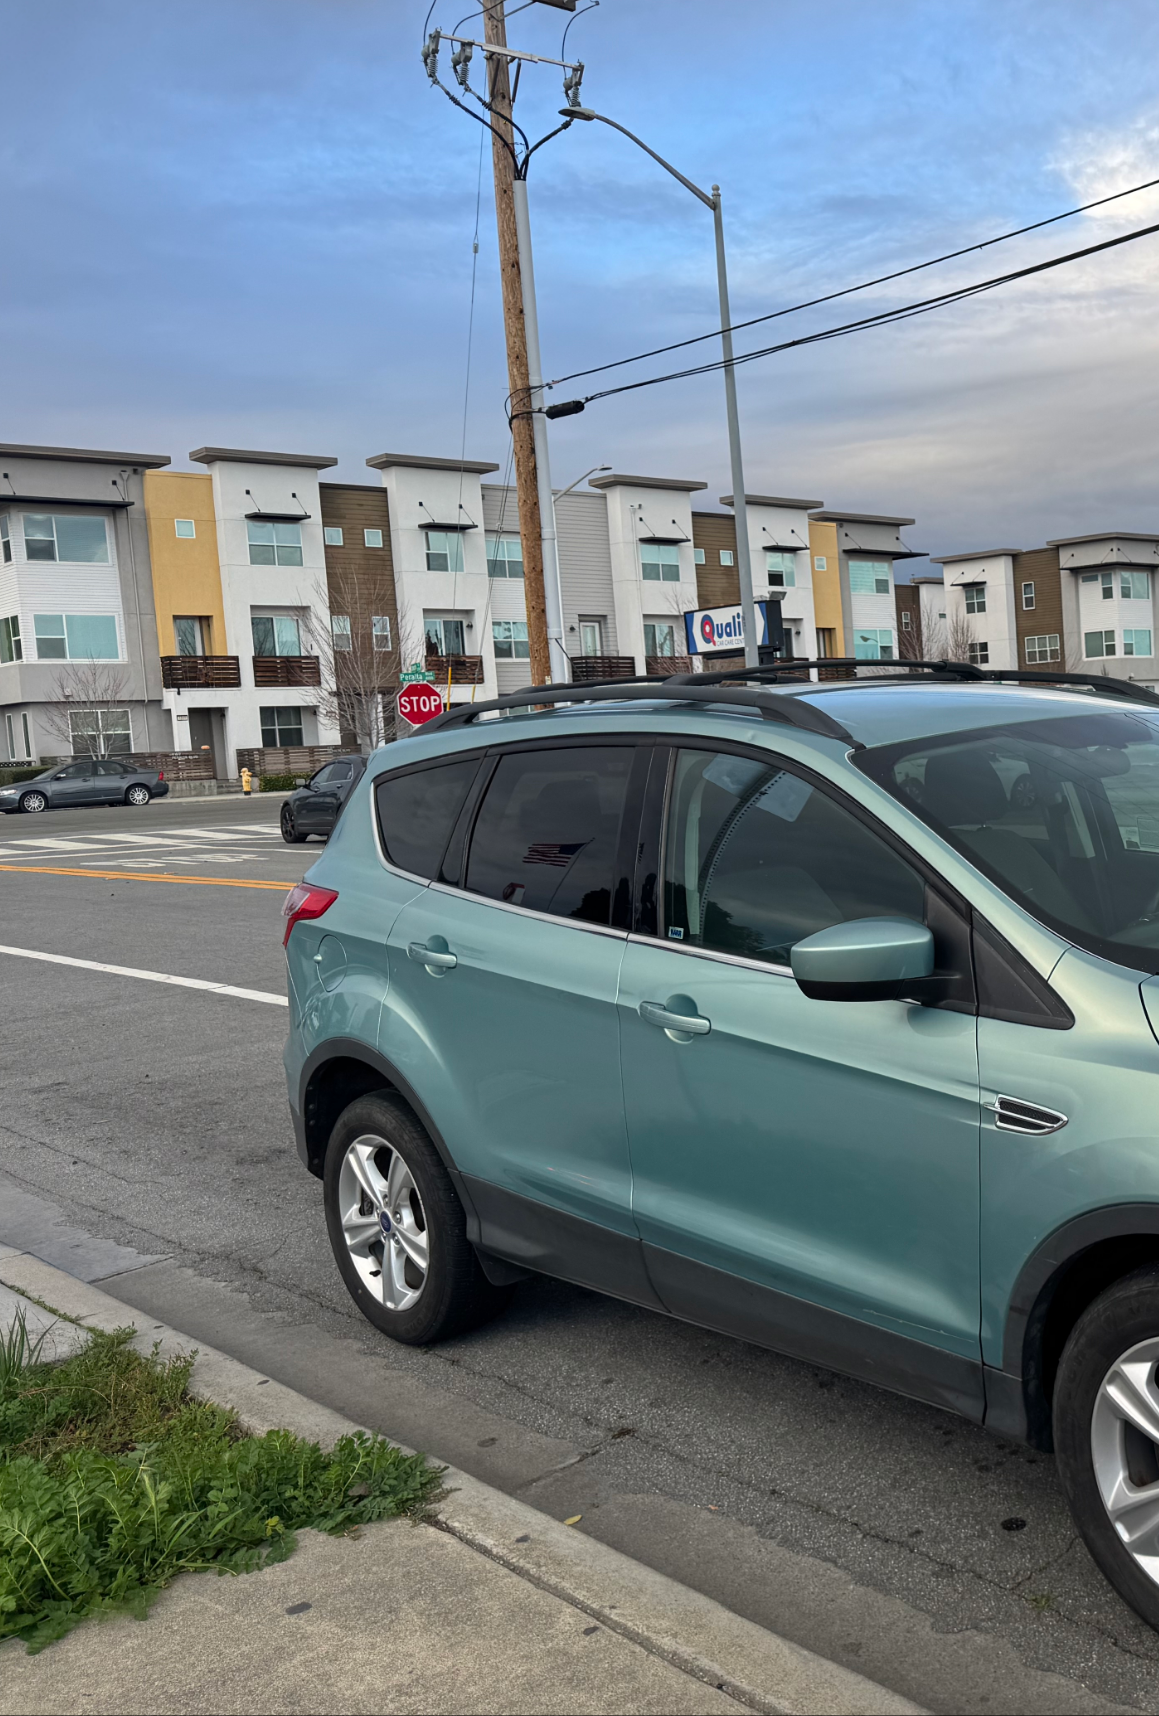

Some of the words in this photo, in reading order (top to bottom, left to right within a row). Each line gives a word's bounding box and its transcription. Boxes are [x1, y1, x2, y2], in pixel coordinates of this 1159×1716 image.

[701, 612, 742, 646] Quali
[400, 672, 423, 681] Peralta
[401, 696, 440, 712] STOP
